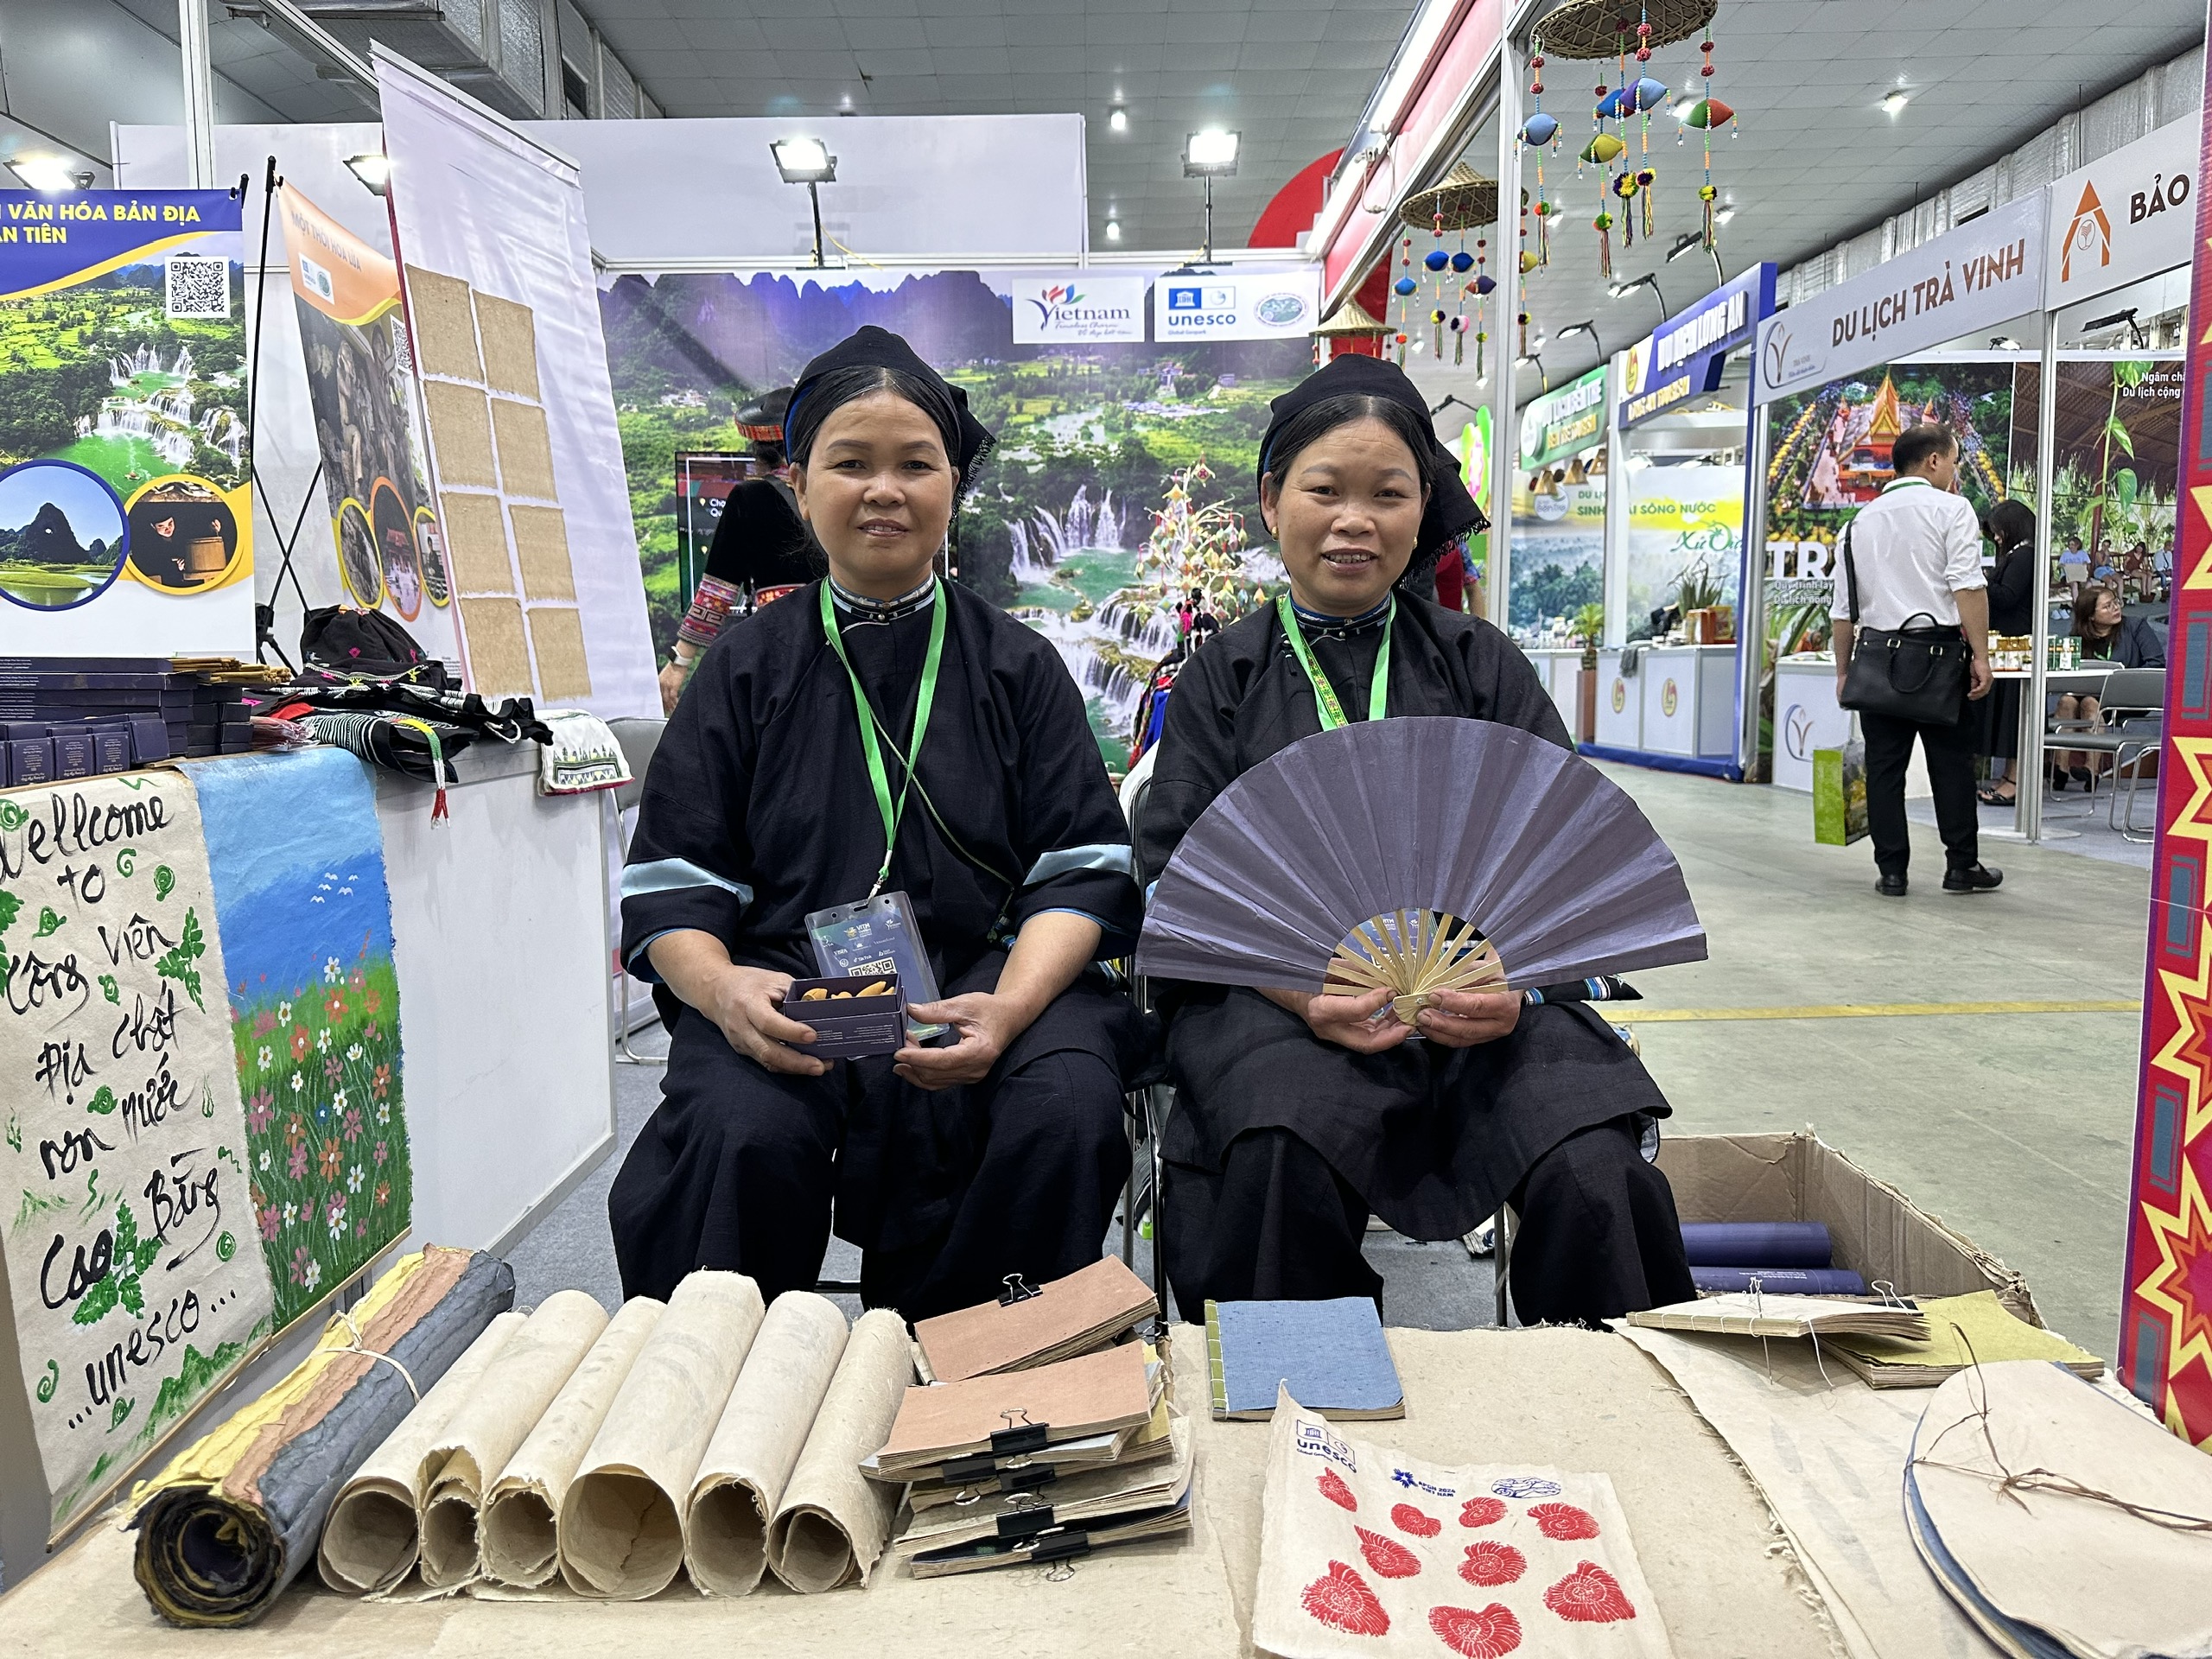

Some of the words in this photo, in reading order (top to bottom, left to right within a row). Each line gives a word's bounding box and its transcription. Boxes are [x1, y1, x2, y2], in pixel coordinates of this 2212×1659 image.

[8, 200, 54, 220] VĂN
[60, 200, 108, 221] HÓA
[113, 199, 157, 221] BẢN
[162, 204, 201, 226] ĐỊA
[2130, 174, 2190, 225] BẢO
[22, 222, 67, 244] TIÊN
[1833, 310, 1857, 347] DU
[1861, 289, 1907, 342] LỊCH
[1912, 260, 1955, 316] TRÀ
[1962, 238, 2025, 295] VINH
[1026, 298, 1131, 331] Vietnam
[1168, 314, 1236, 327] unesco
[1726, 289, 1748, 334] AN
[2141, 371, 2169, 385] Ngâm
[2122, 386, 2135, 397] Du
[2138, 386, 2155, 398] lịch
[2157, 386, 2181, 398] cộng
[1578, 491, 1592, 499] DU
[1640, 502, 1676, 515] SÔNG
[1680, 501, 1716, 513] NƯỚC
[1577, 505, 1605, 516] SINH
[1670, 531, 1707, 552] Xứ
[1765, 541, 1835, 580] TR
[57, 864, 105, 915] to
[855, 922, 871, 931] VITM
[40, 1127, 116, 1180] non
[40, 1229, 113, 1310] Cao
[1297, 1439, 1357, 1473] unesco
